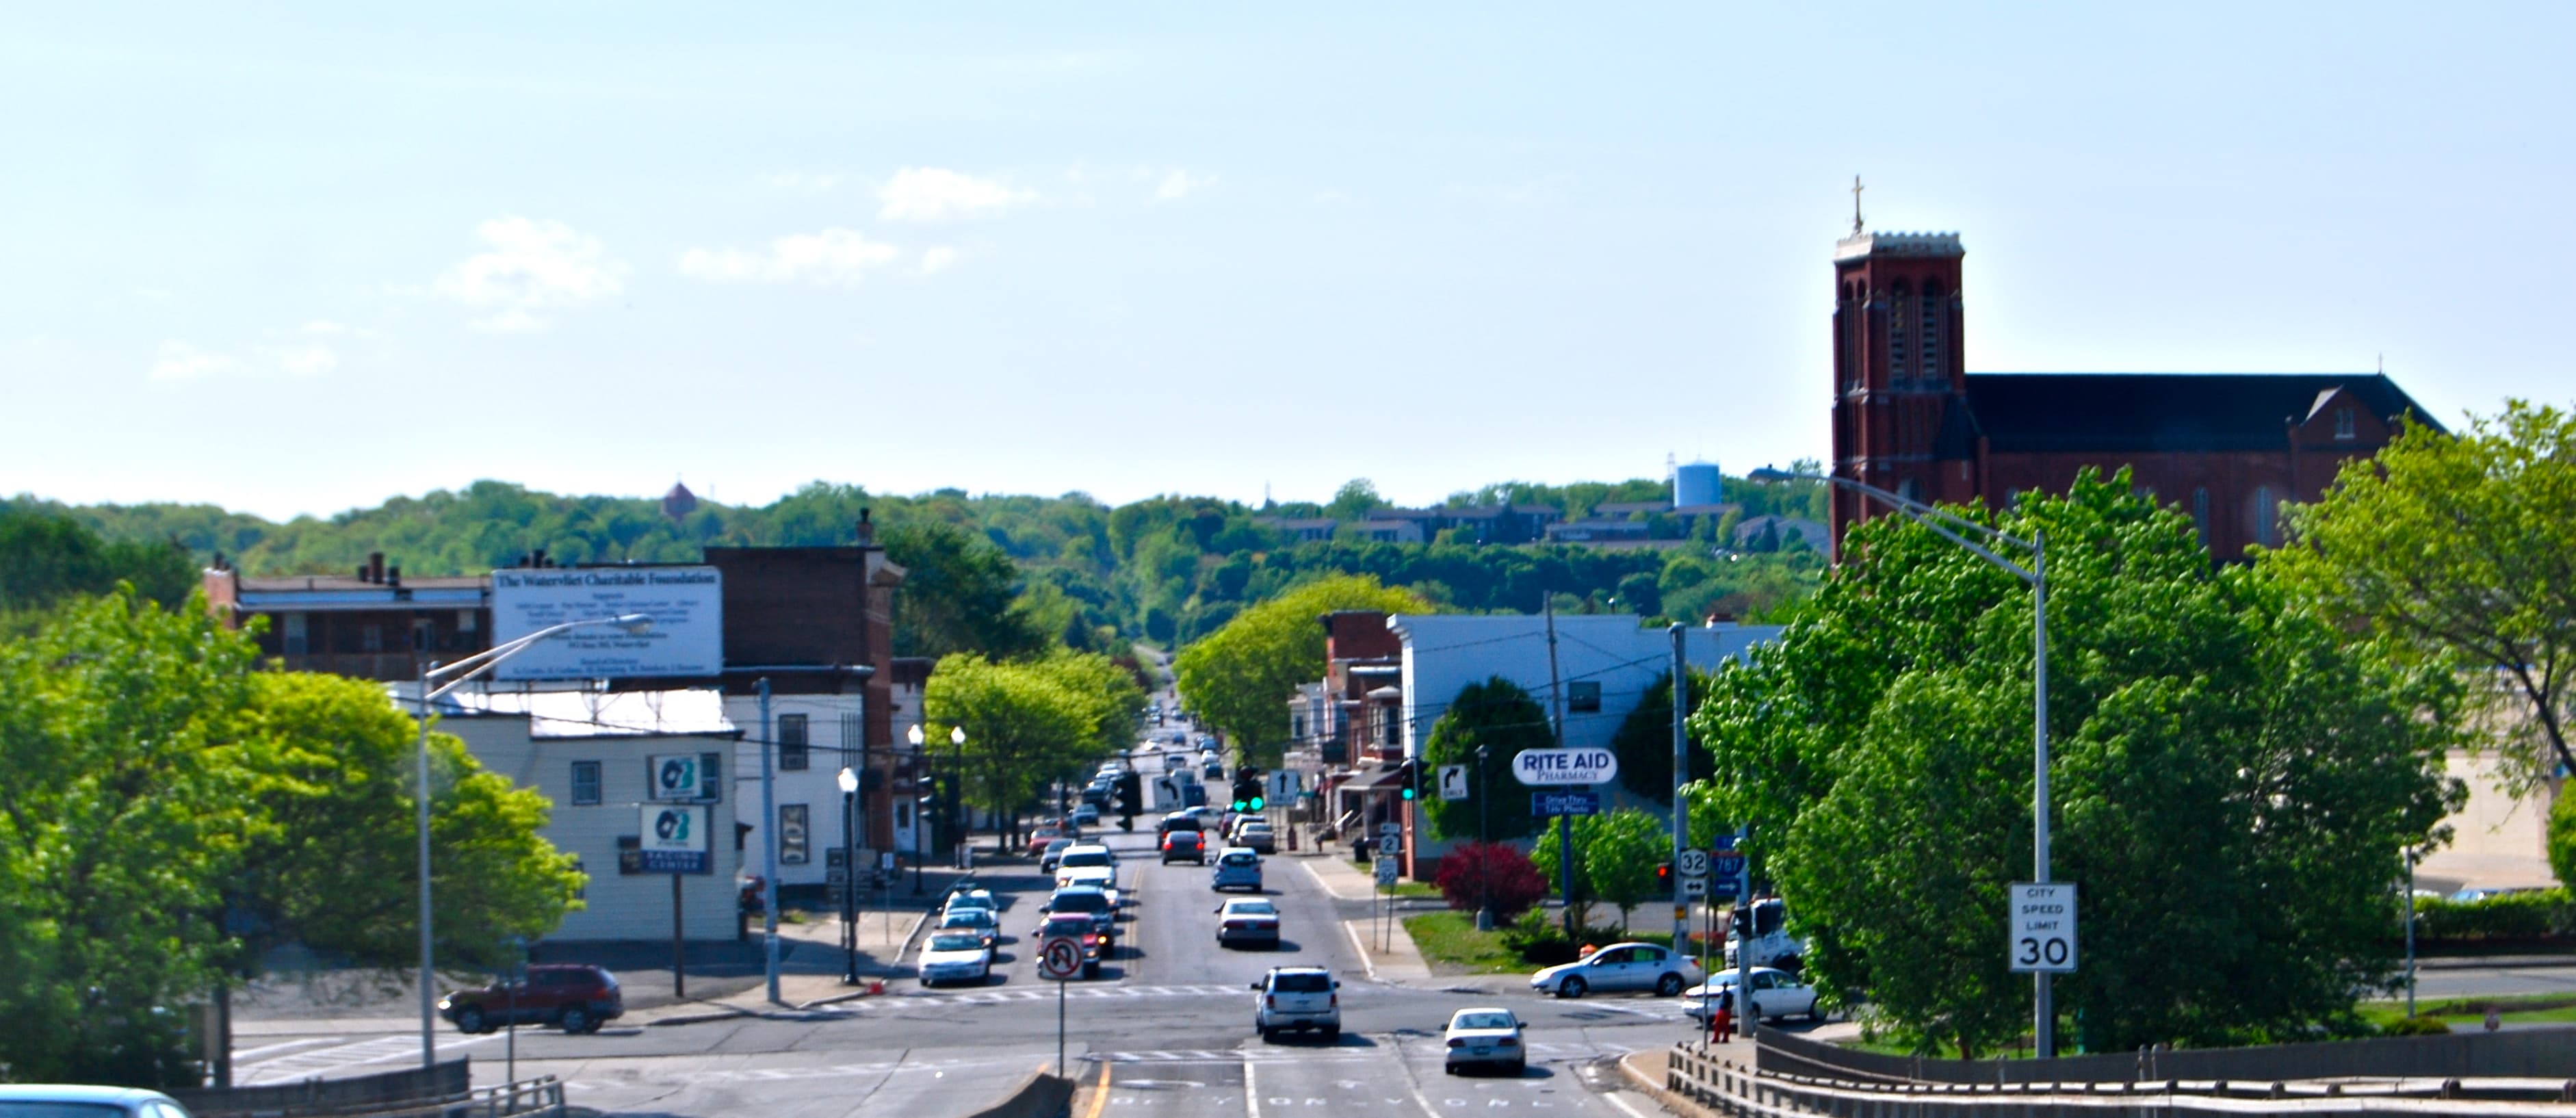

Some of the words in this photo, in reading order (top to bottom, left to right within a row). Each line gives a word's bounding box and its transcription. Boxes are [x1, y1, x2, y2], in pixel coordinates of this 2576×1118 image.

[498, 575, 520, 587] The
[522, 574, 581, 586] Watervliet
[584, 573, 645, 585] Charitable
[649, 571, 715, 584] Foundation
[1523, 754, 1567, 770] RITE
[1574, 753, 1610, 769] AID
[1537, 770, 1598, 781] PHARMACY
[1384, 837, 1394, 850] 2
[1682, 855, 1704, 871] 32
[1717, 858, 1739, 870] 787
[2027, 888, 2055, 898] CITY
[2022, 904, 2064, 914] SPEED
[2026, 921, 2059, 931] LIMIT
[2019, 937, 2068, 965] 30
